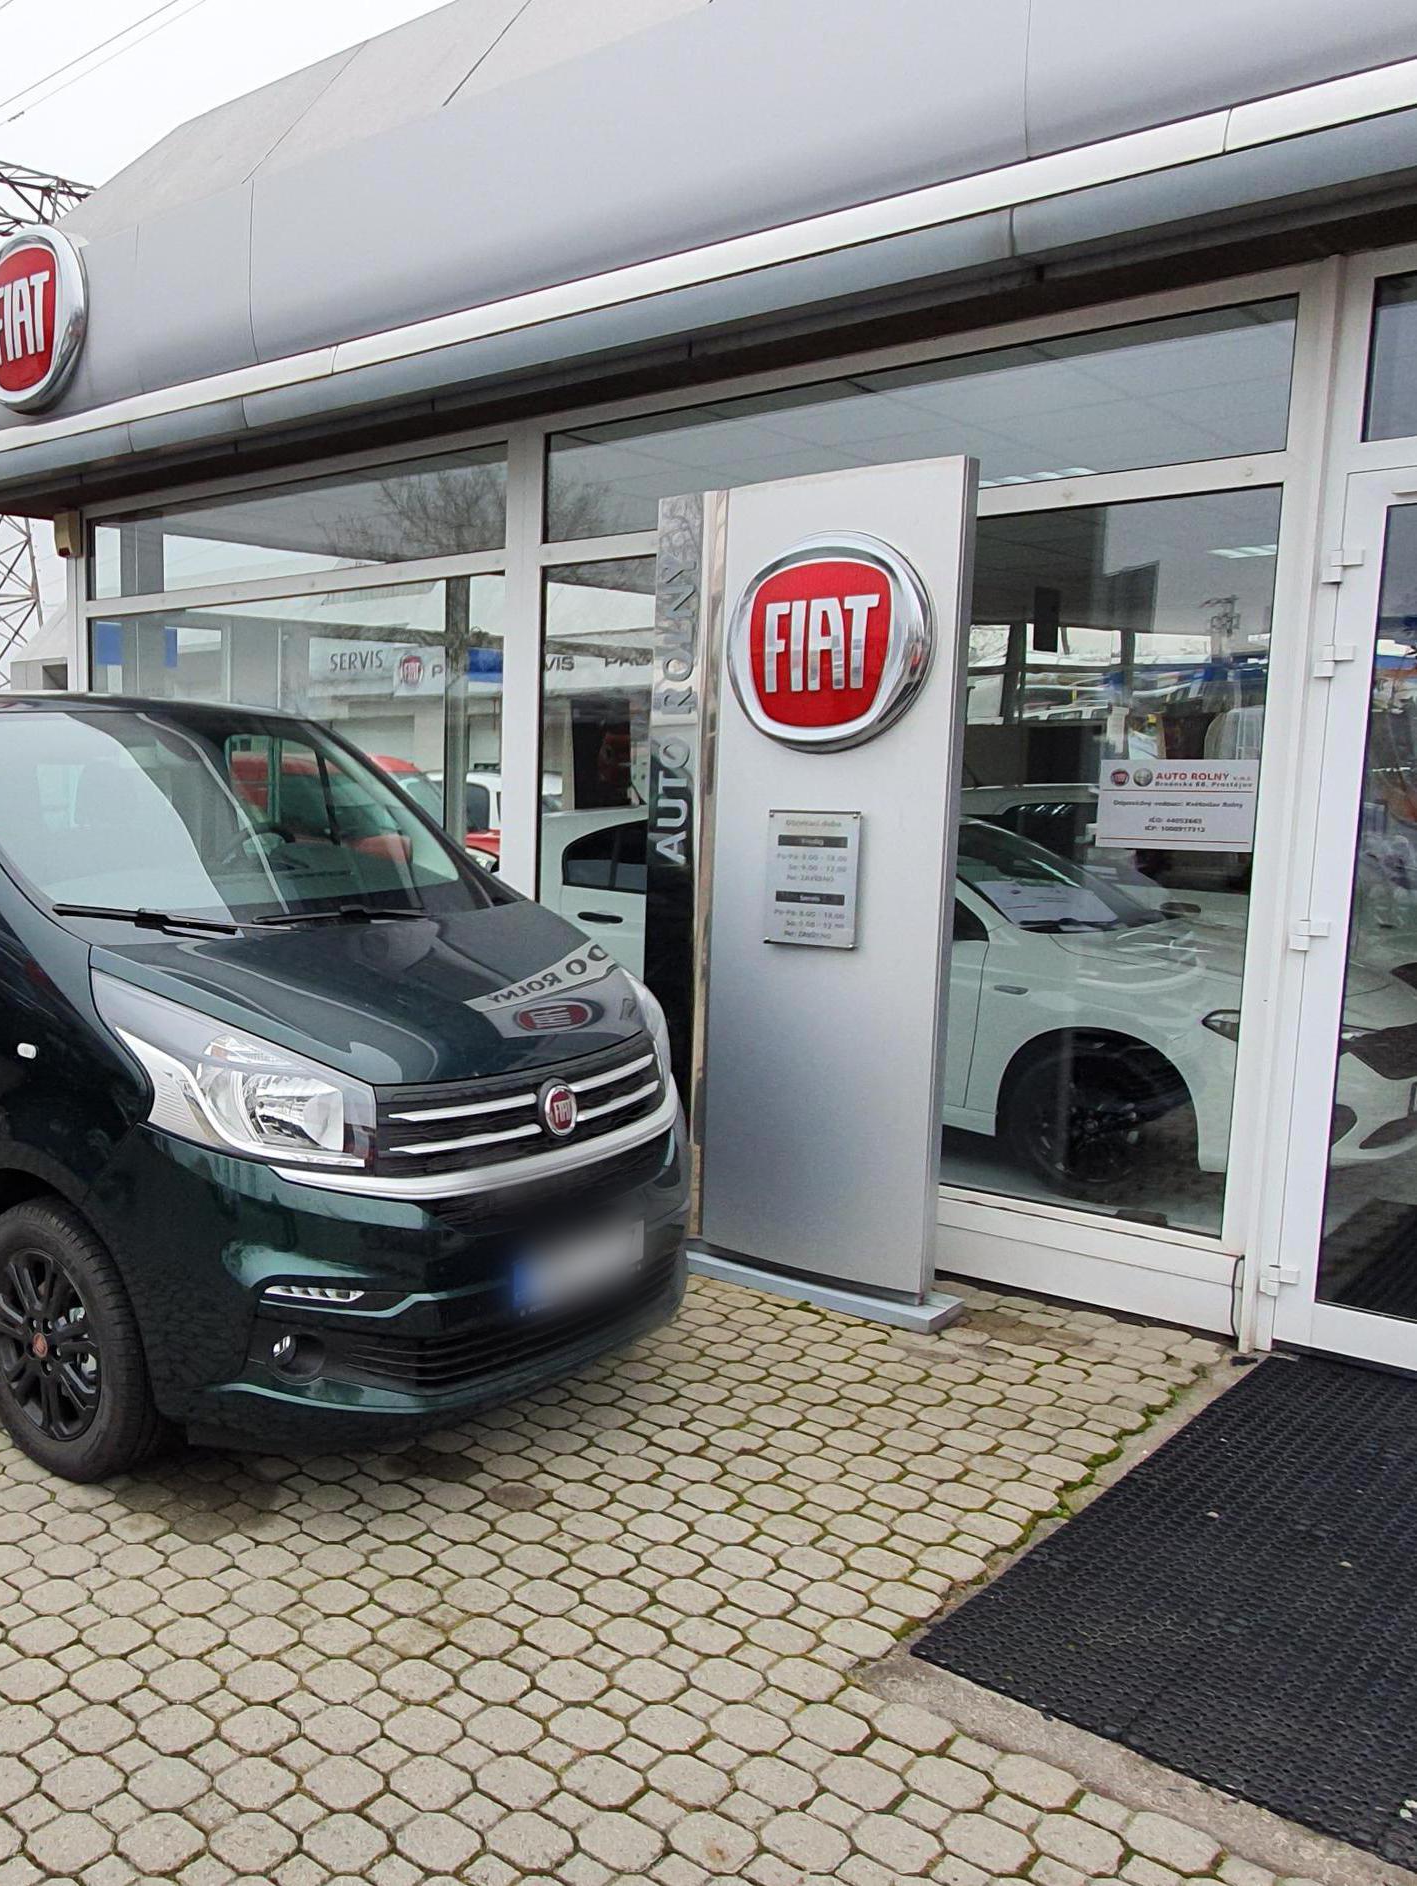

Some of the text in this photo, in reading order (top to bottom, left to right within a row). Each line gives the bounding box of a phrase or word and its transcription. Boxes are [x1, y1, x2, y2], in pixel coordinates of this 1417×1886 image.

[765, 593, 880, 694] FIAT
[330, 650, 383, 672] SERVIS
[545, 655, 575, 671] VIS
[1155, 772, 1188, 781] AUTO
[656, 735, 691, 865] AUTO
